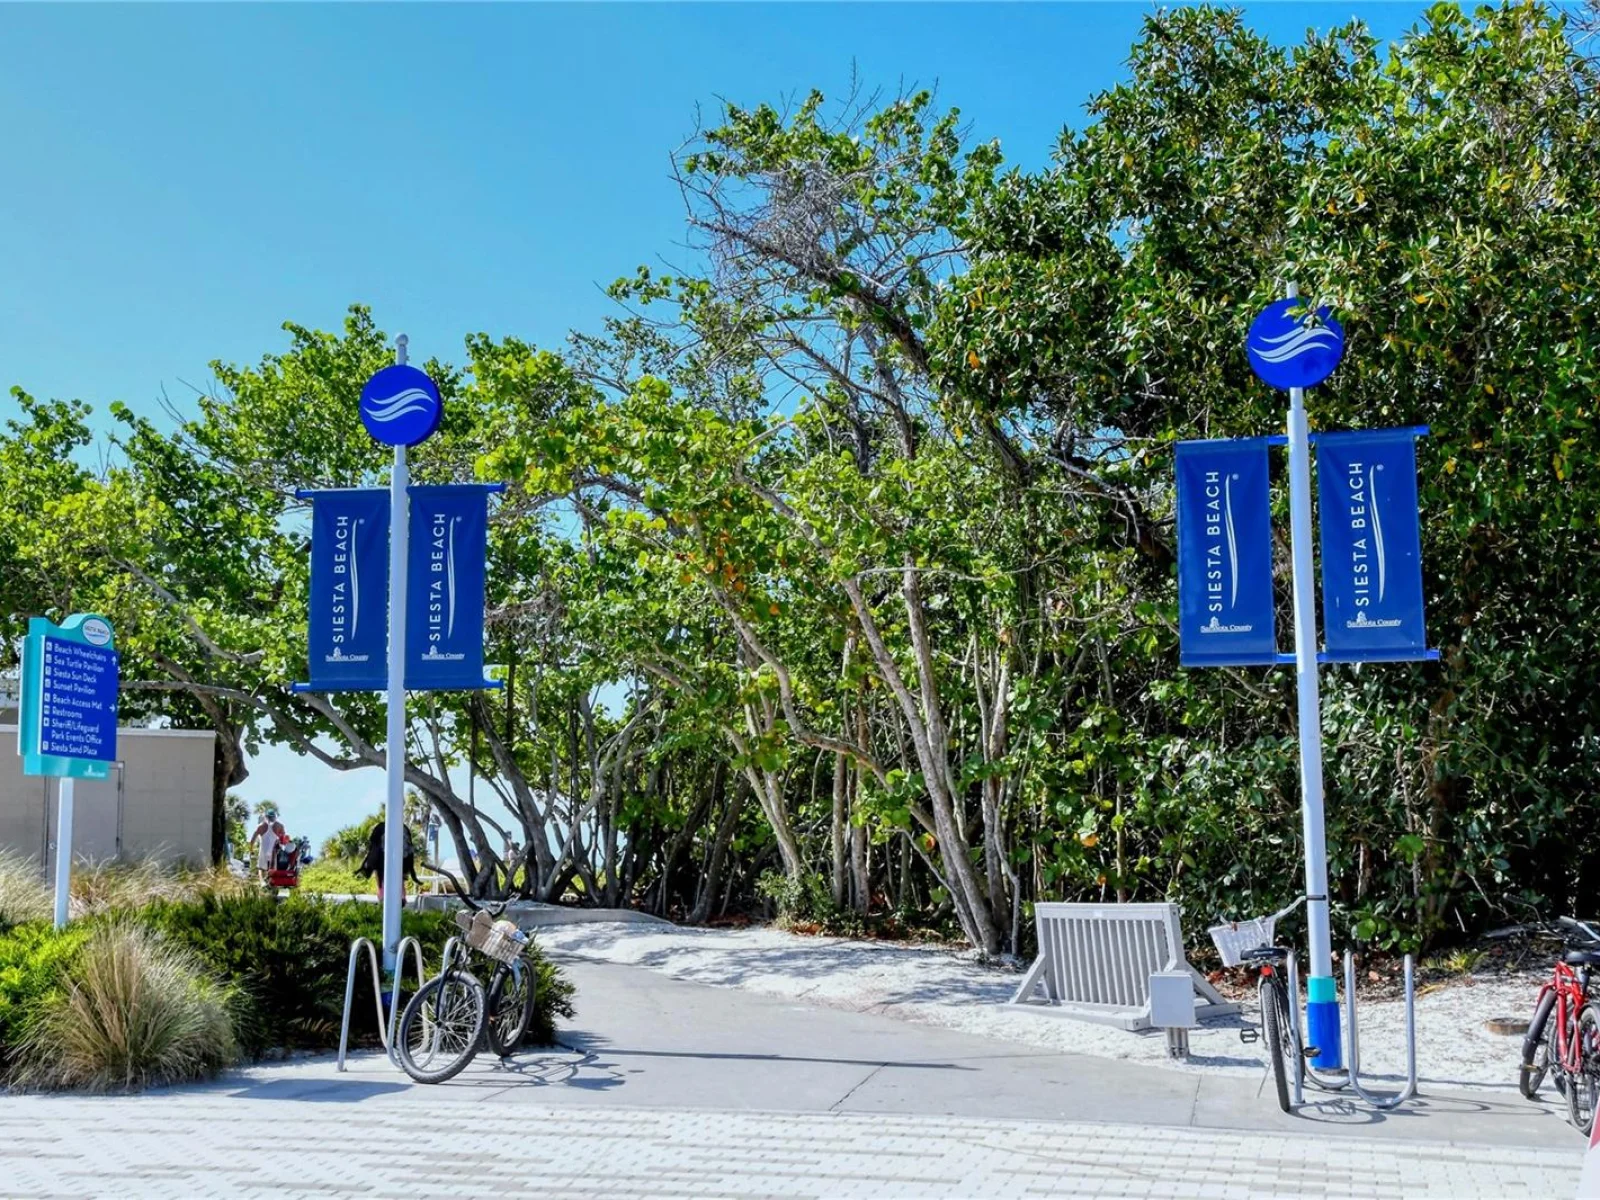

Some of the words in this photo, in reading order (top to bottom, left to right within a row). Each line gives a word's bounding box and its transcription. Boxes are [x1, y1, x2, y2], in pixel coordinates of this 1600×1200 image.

[1206, 471, 1221, 536] BEACH
[1349, 462, 1366, 528] BEACH
[334, 516, 348, 573] BEACH
[431, 513, 445, 571] BEACH
[1208, 545, 1222, 612] SIESTA
[1353, 538, 1370, 607] SIESTA
[333, 582, 345, 643] SIESTA
[429, 580, 442, 641] SIESTA
[54, 643, 72, 655] Beach
[73, 646, 107, 662] Wheelchairs
[54, 655, 65, 666] Sea
[67, 657, 82, 669] Turtle
[83, 660, 105, 673] Pavilion
[53, 679, 72, 691] Sunset
[74, 683, 96, 695] Pavilion
[54, 667, 71, 679] Siesta
[71, 670, 82, 681] Sun
[83, 672, 97, 684] Deck
[52, 706, 83, 719] Restrooms
[53, 693, 71, 705] Beach
[72, 698, 91, 708] Access
[91, 700, 103, 710] Mat
[51, 741, 68, 753] Siesta
[69, 743, 83, 754] Sand
[52, 729, 65, 740] Park
[66, 731, 84, 743] Events
[86, 733, 103, 745] Office
